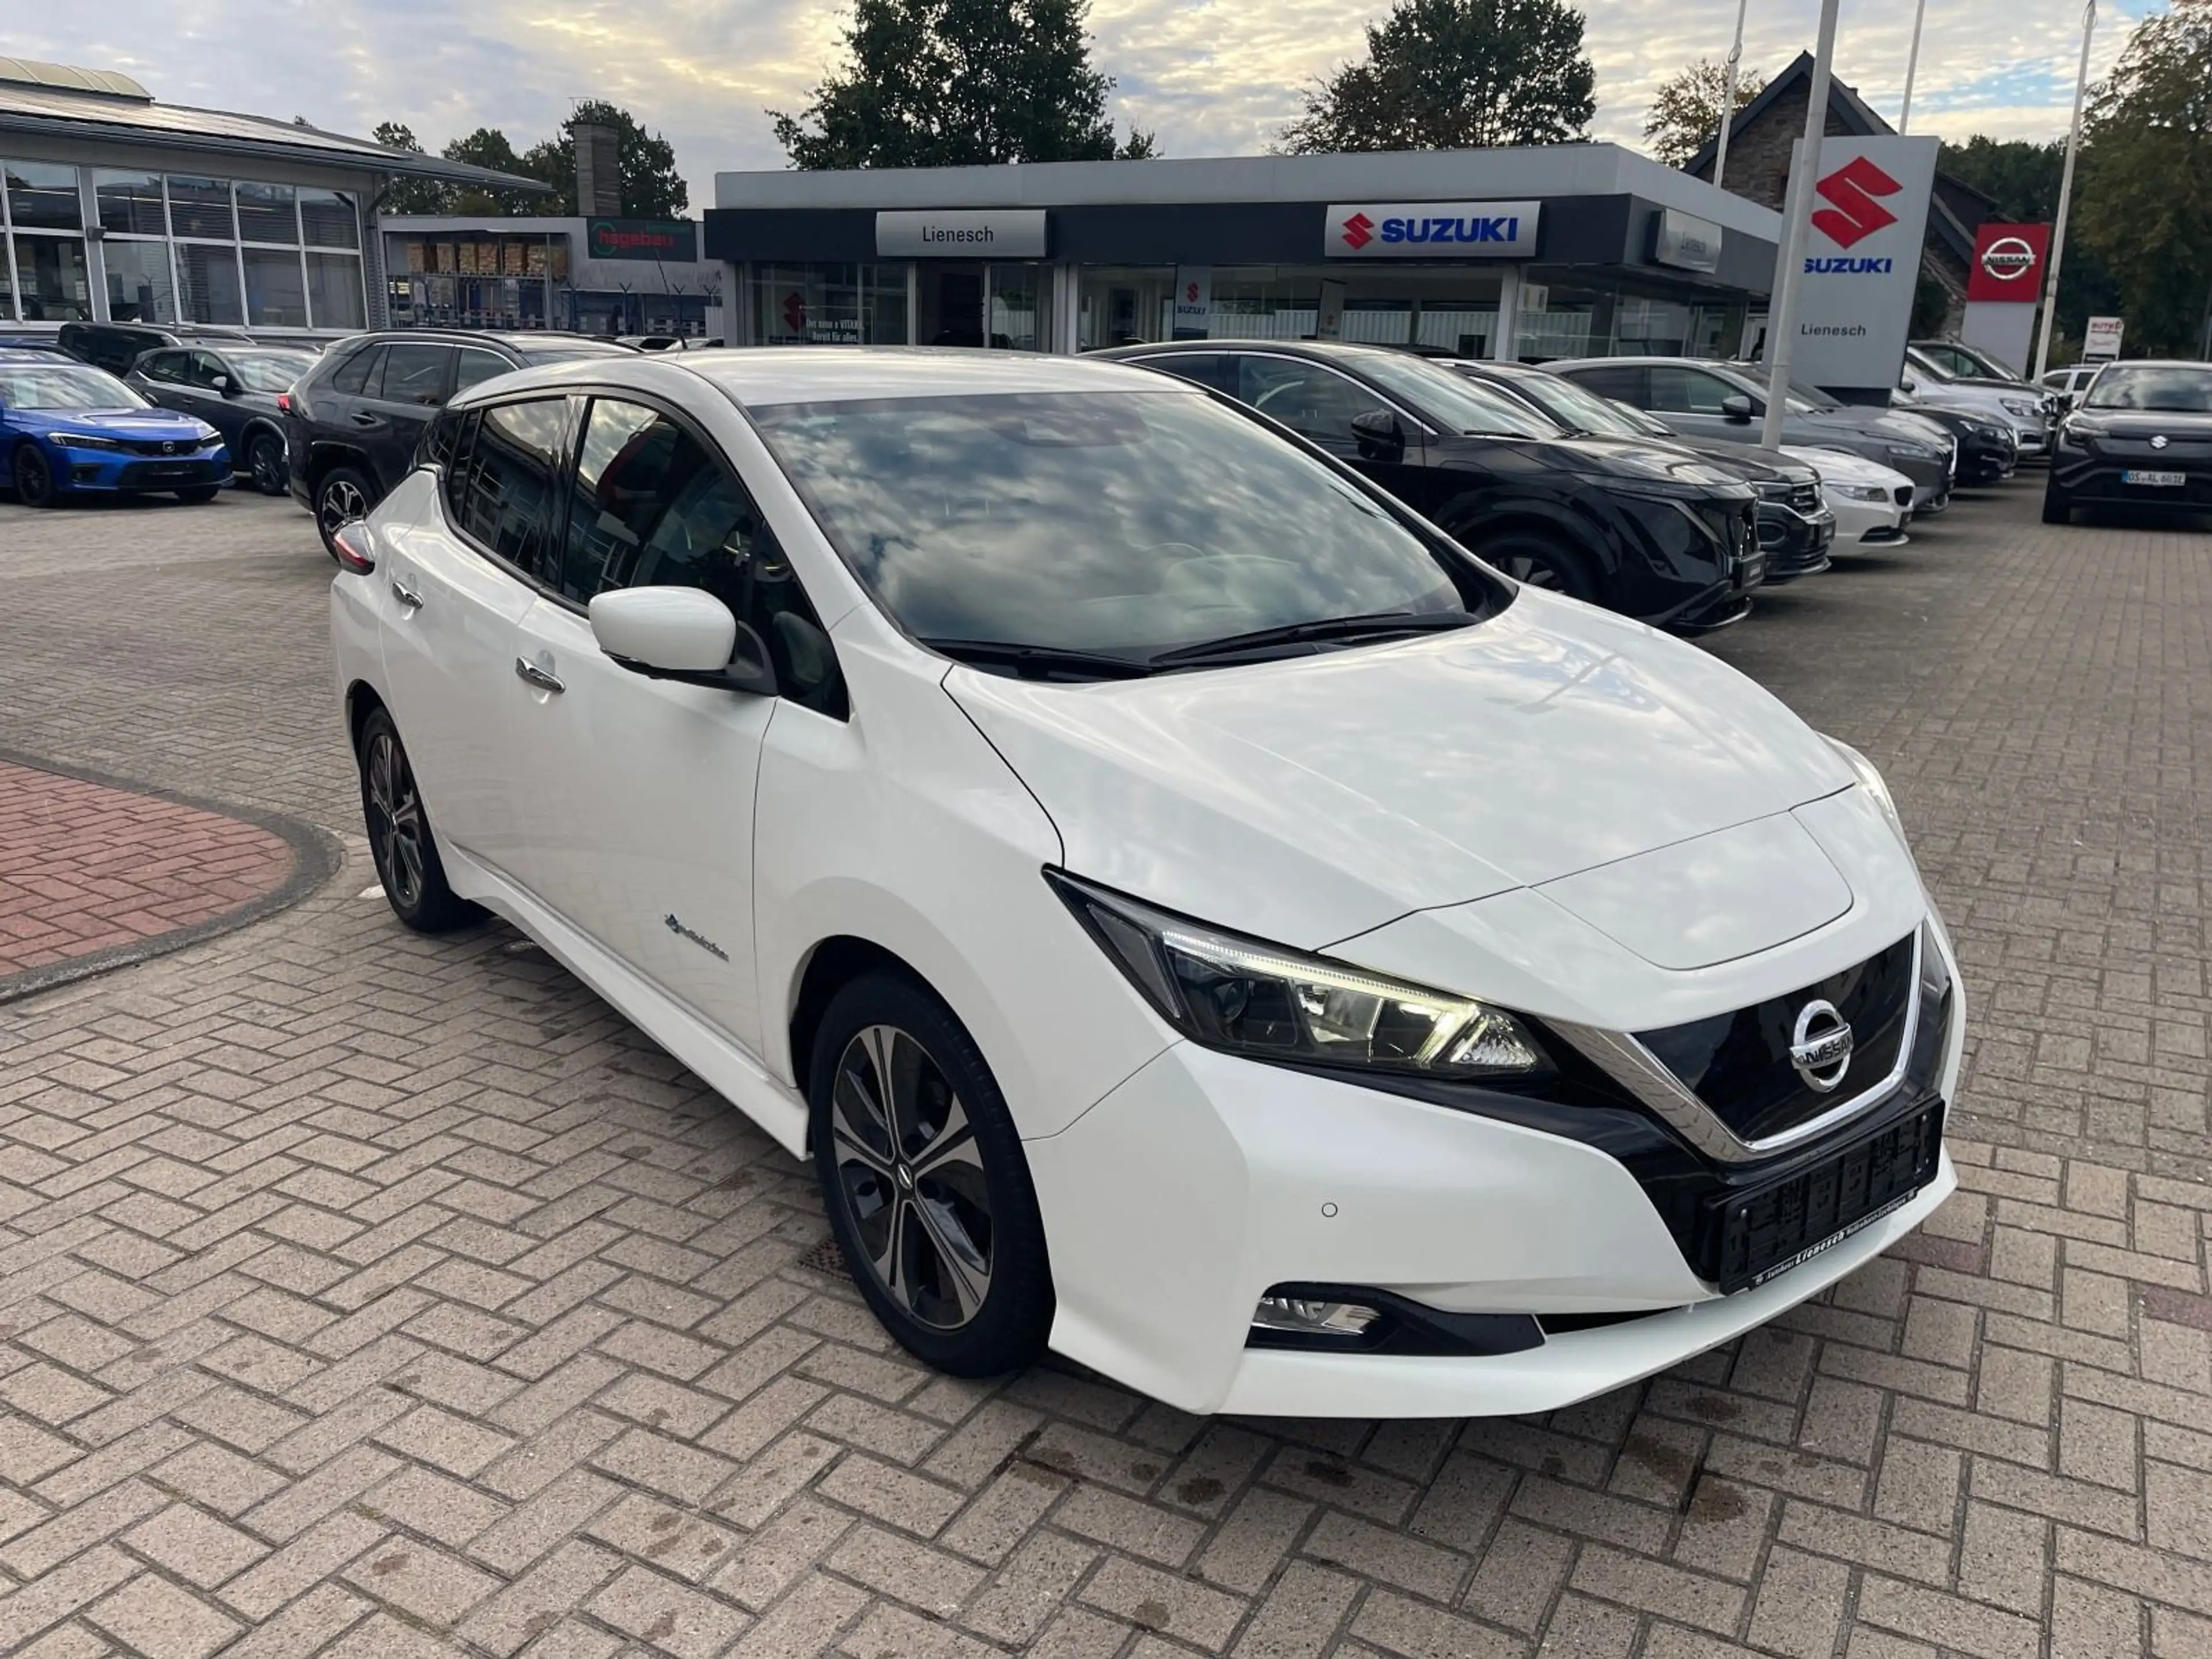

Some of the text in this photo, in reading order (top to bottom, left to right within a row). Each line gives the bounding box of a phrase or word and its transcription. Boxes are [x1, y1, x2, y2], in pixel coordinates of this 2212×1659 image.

[922, 225, 994, 242] Lienesch
[1381, 217, 1518, 243] SUZUKI
[1801, 323, 1866, 336] Lienesch
[1796, 1230, 1844, 1264] Lienesch
